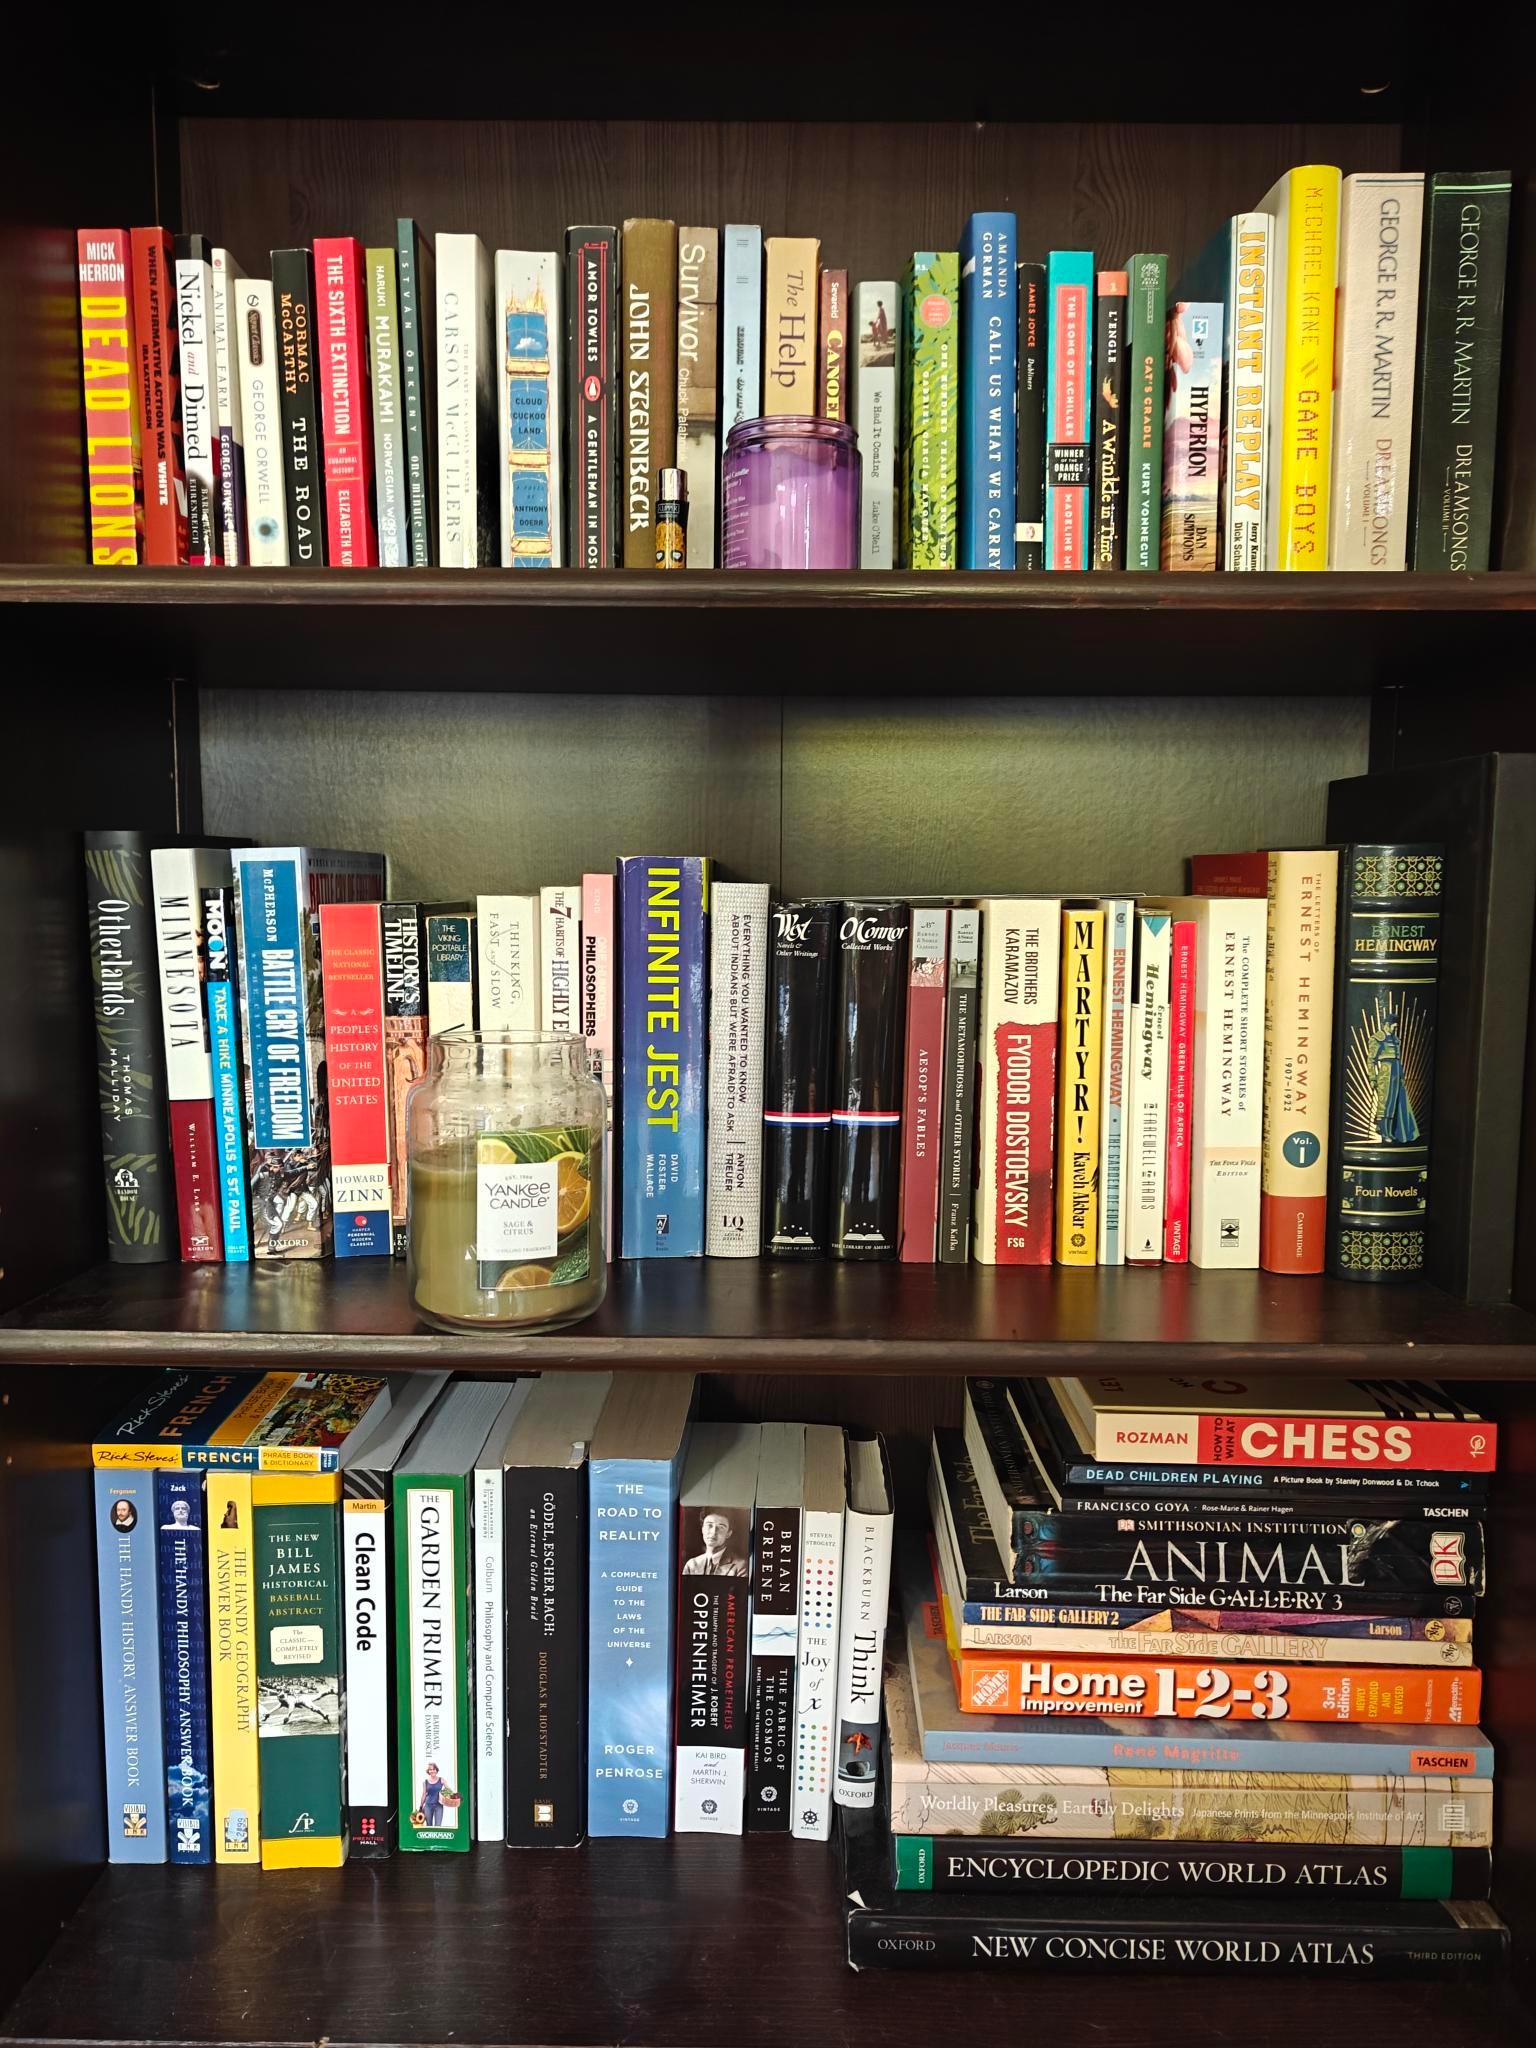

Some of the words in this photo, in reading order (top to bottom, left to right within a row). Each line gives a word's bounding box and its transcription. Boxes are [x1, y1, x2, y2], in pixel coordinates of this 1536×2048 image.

[86, 242, 115, 260] MICK
[983, 232, 992, 299] GORMAN
[998, 233, 1007, 298] AMANDA
[1458, 205, 1481, 291] GEORGE
[79, 262, 125, 283] HERRON
[326, 256, 343, 285] THE
[376, 265, 386, 307] HARUKI
[786, 271, 804, 307] The
[179, 272, 203, 346] Nickel
[329, 293, 345, 337] SIXTH
[629, 283, 650, 360] JOHN
[680, 243, 705, 362] Survivor
[1237, 232, 1266, 373] INSTANT
[81, 296, 130, 410] DEAD
[281, 294, 296, 394] McCARTHY
[295, 304, 309, 384] CORMAC
[770, 311, 805, 388] Help
[989, 316, 1002, 365] CALL
[187, 352, 197, 375] and
[376, 316, 393, 422] MURAKAMI
[1451, 341, 1475, 424] MARTIN
[331, 343, 351, 435] EXTINCTION
[989, 374, 1001, 398] US
[184, 383, 207, 460] Dimed
[513, 412, 546, 420] CUCKOO
[989, 408, 1001, 463] WHAT
[1188, 386, 1209, 478] HYPERION
[292, 419, 308, 471] THE
[629, 370, 650, 532] STEINBECK
[1054, 450, 1084, 458] WINNER
[1235, 386, 1262, 512] REPLAY
[989, 469, 1001, 499] WE
[1054, 463, 1084, 472] ORANGE
[1058, 472, 1080, 481] PRIZE
[88, 438, 137, 565] LIONS
[1449, 445, 1472, 572] DREAMSONGS
[295, 487, 312, 560] ROAD
[989, 508, 1001, 569] CARRY
[263, 869, 278, 942] McPHERSON
[205, 900, 226, 969] MOON
[742, 914, 751, 980] EVERYTHING
[772, 913, 814, 942] West
[840, 916, 909, 943] O'Connor
[1354, 938, 1438, 952] HEMINGWAY
[1371, 925, 1426, 938] ERNEST
[97, 900, 135, 1016] Otherlands
[387, 919, 403, 1003] TIMELINE
[403, 918, 420, 1003] HISTORY'S
[646, 867, 679, 1033] INFINITE
[1003, 928, 1019, 1004] KARAMAZOV
[159, 896, 199, 1049] MINNESOTA
[261, 949, 293, 1003] BATTLE
[585, 936, 595, 1037] PHILOSOPHERS
[1024, 949, 1038, 1005] BROTHERS
[215, 988, 227, 1023] TAKE
[266, 1007, 295, 1040] CRY
[1141, 964, 1160, 1081] Hemingway
[330, 1025, 378, 1033] PEOPLE'S
[330, 1043, 378, 1051] HISTORY
[1074, 921, 1093, 1143] MARTYR!
[217, 1037, 231, 1070] HIKE
[268, 1046, 300, 1063] OF
[1007, 1035, 1031, 1105] FYODOR
[109, 1047, 121, 1123] HALLIDAY
[121, 1054, 133, 1118] THOMAS
[332, 1079, 380, 1087] UNITED
[646, 1045, 678, 1132] JEST
[919, 1049, 928, 1102] AESOP'S
[220, 1073, 236, 1162] MINNEAPOLIS
[271, 1069, 304, 1140] FREEDOM
[335, 1096, 378, 1105] STATES
[916, 1105, 926, 1158] FABLES
[335, 1174, 384, 1184] HOWARD
[645, 1154, 654, 1198] WALLACE
[658, 1154, 666, 1191] FOSTER
[670, 1154, 678, 1183] DAVID
[725, 1153, 733, 1191] TREUER
[736, 1153, 744, 1189] ANTON
[1004, 1111, 1030, 1227] DOSTOEVSKY
[1072, 1153, 1090, 1190] Kaveh
[337, 1189, 383, 1202] ZINN
[1072, 1188, 1086, 1229] Akbar
[1355, 1186, 1380, 1197] Four
[1385, 1186, 1418, 1197] Novels
[227, 1200, 240, 1234] PAUL
[1007, 1237, 1024, 1248] FSG
[187, 1451, 253, 1464] FRENCH
[1116, 1431, 1187, 1445] ROZMAN
[1240, 1422, 1412, 1461] CHESS
[617, 1485, 644, 1494] THE
[1086, 1469, 1125, 1481] DEAD
[1128, 1470, 1199, 1483] CHILDREN
[1203, 1473, 1264, 1485] PLAYING
[597, 1507, 638, 1518] ROAD
[643, 1507, 662, 1518] TO
[1077, 1501, 1151, 1511] FRANCISCO
[1154, 1501, 1190, 1512] GOYA
[1423, 1507, 1469, 1517] TASCHEN
[600, 1531, 660, 1541] REALITY
[1138, 1519, 1242, 1533] SMITHSONIAN
[1246, 1521, 1348, 1536] INSTITUTION
[269, 1562, 320, 1574] JAMES
[277, 1548, 313, 1558] BILL
[355, 1532, 375, 1591] Clean
[421, 1507, 441, 1608] GARDEN
[761, 1520, 775, 1602] GREENE
[779, 1531, 790, 1593] BRIAN
[1121, 1539, 1366, 1587] ANIMAL
[263, 1579, 328, 1588] HISTORICAL
[270, 1593, 322, 1602] BASEBALL
[994, 1582, 1048, 1599] Larson
[1095, 1584, 1133, 1603] The
[1136, 1584, 1167, 1604] Far
[1169, 1585, 1206, 1605] Side
[268, 1607, 323, 1616] ABSTRACT
[355, 1598, 377, 1652] Code
[482, 1600, 494, 1653] Philosophy
[980, 1607, 1003, 1621] THE
[1004, 1607, 1027, 1623] FAR
[1029, 1608, 1056, 1623] SIDE
[1058, 1609, 1110, 1625] GALLERY
[1109, 1611, 1120, 1626] 2
[423, 1619, 443, 1709] PRIMER
[485, 1654, 494, 1672] and
[691, 1593, 709, 1728] OPPENHEIMER
[801, 1651, 831, 1672] Joy
[851, 1630, 876, 1703] Think
[1021, 1663, 1145, 1697] Home
[484, 1673, 495, 1720] Computer
[1021, 1696, 1142, 1714] Improvement
[1152, 1668, 1290, 1720] 1-2-3
[484, 1721, 495, 1758] Science
[604, 1745, 655, 1755] ROGER
[596, 1768, 663, 1778] PENROSE
[1417, 1757, 1468, 1767] TASCHEN
[839, 1789, 872, 1799] OXFORD
[920, 1796, 980, 1812] Worldly
[984, 1797, 1058, 1814] Pleasures,
[948, 1857, 1169, 1881] ENCYCLOPEDIC
[1178, 1862, 1286, 1884] WORLD
[1296, 1865, 1387, 1886] ATLAS
[972, 1936, 1038, 1957] NEW
[1045, 1937, 1165, 1960] CONCISE
[1175, 1940, 1280, 1962] WORLD
[1289, 1943, 1374, 1965] ATLAS
